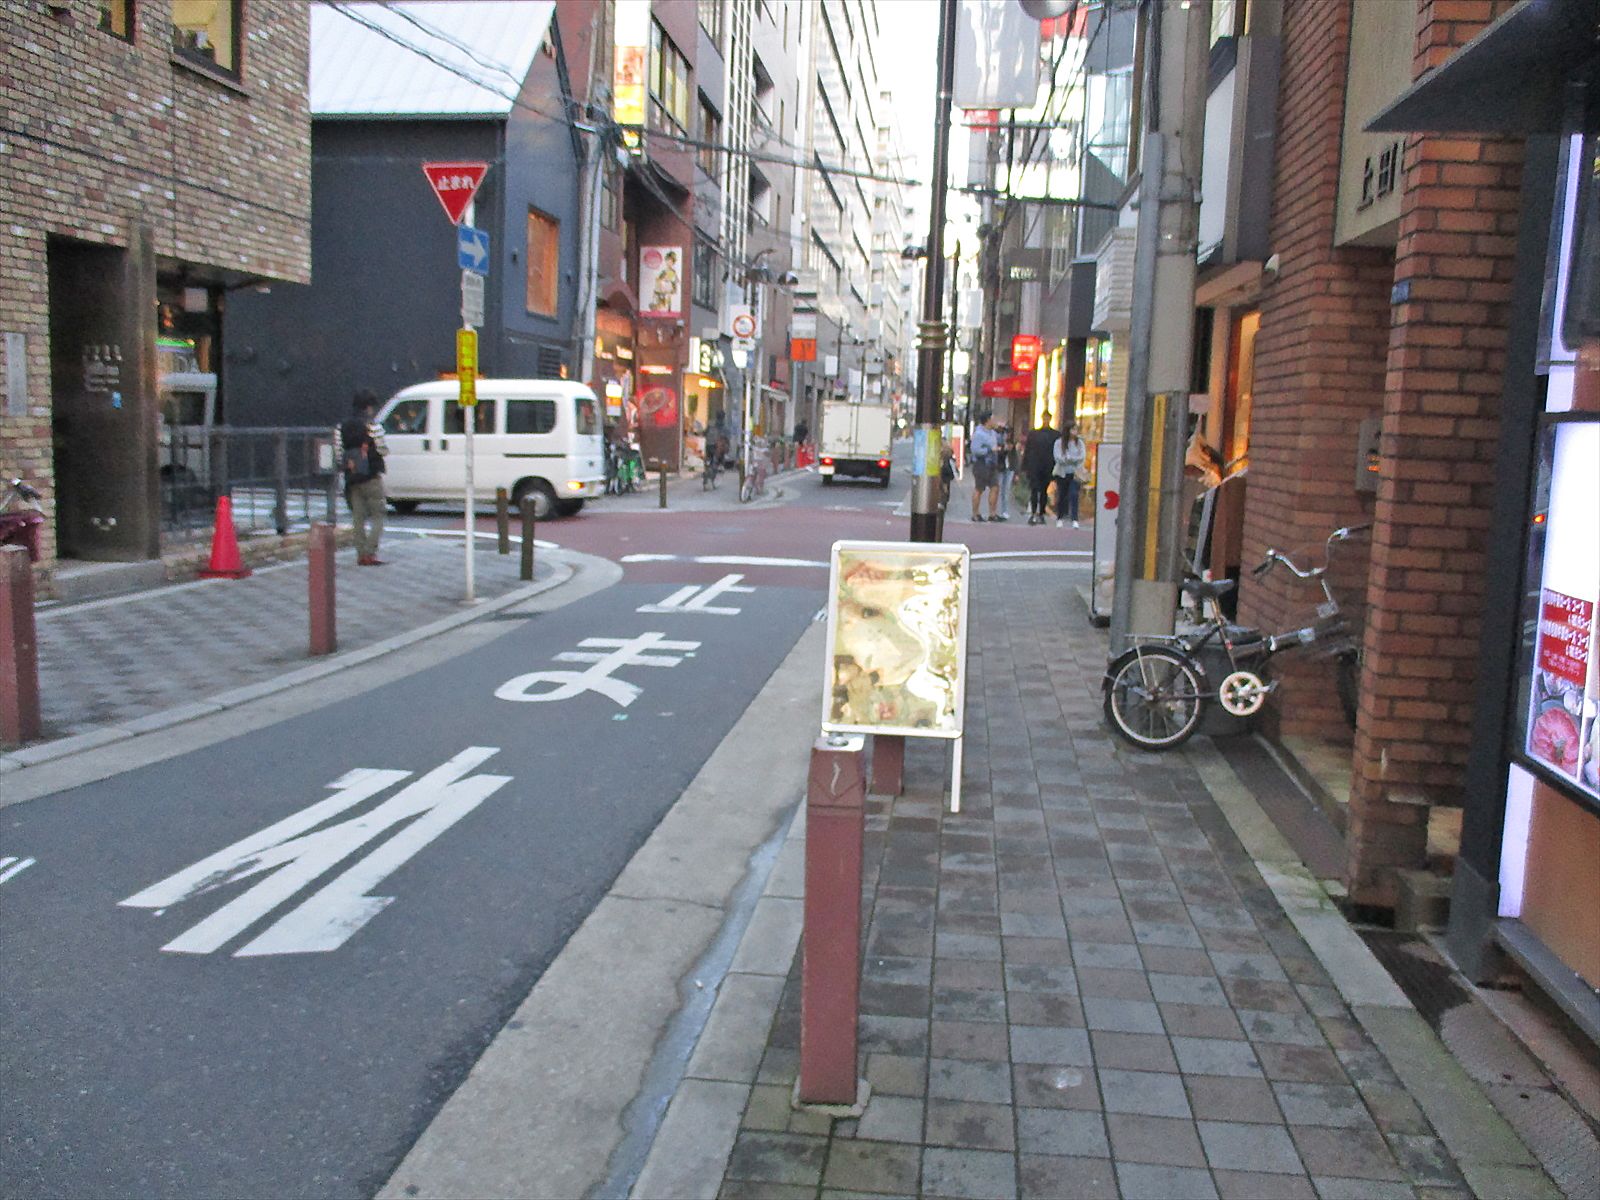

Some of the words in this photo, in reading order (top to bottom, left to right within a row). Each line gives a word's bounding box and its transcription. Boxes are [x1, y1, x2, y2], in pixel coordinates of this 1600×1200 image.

[438, 175, 475, 191] 止まれ
[119, 573, 755, 957] 止まれ
